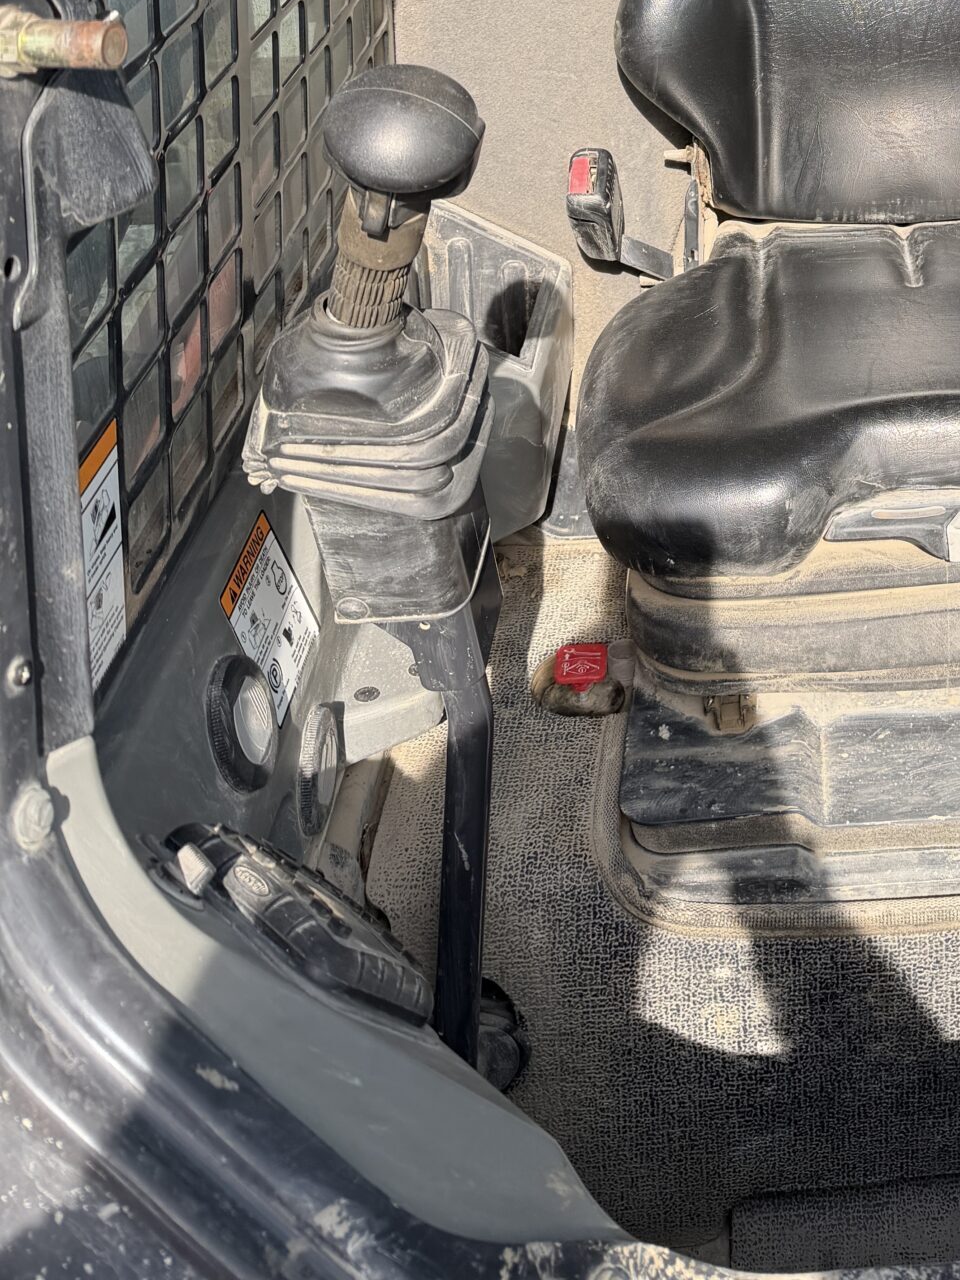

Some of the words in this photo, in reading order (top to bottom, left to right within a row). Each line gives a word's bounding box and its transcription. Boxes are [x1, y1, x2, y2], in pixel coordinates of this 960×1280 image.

[233, 526, 265, 590] WARNING
[237, 593, 247, 612] AVOID
[245, 573, 256, 594] INJURY
[254, 563, 261, 575] OR
[258, 545, 269, 563] DEATH
[276, 573, 285, 590] STOP
[241, 608, 249, 618] TO
[246, 590, 256, 609] LEAVE
[253, 578, 261, 591] THE
